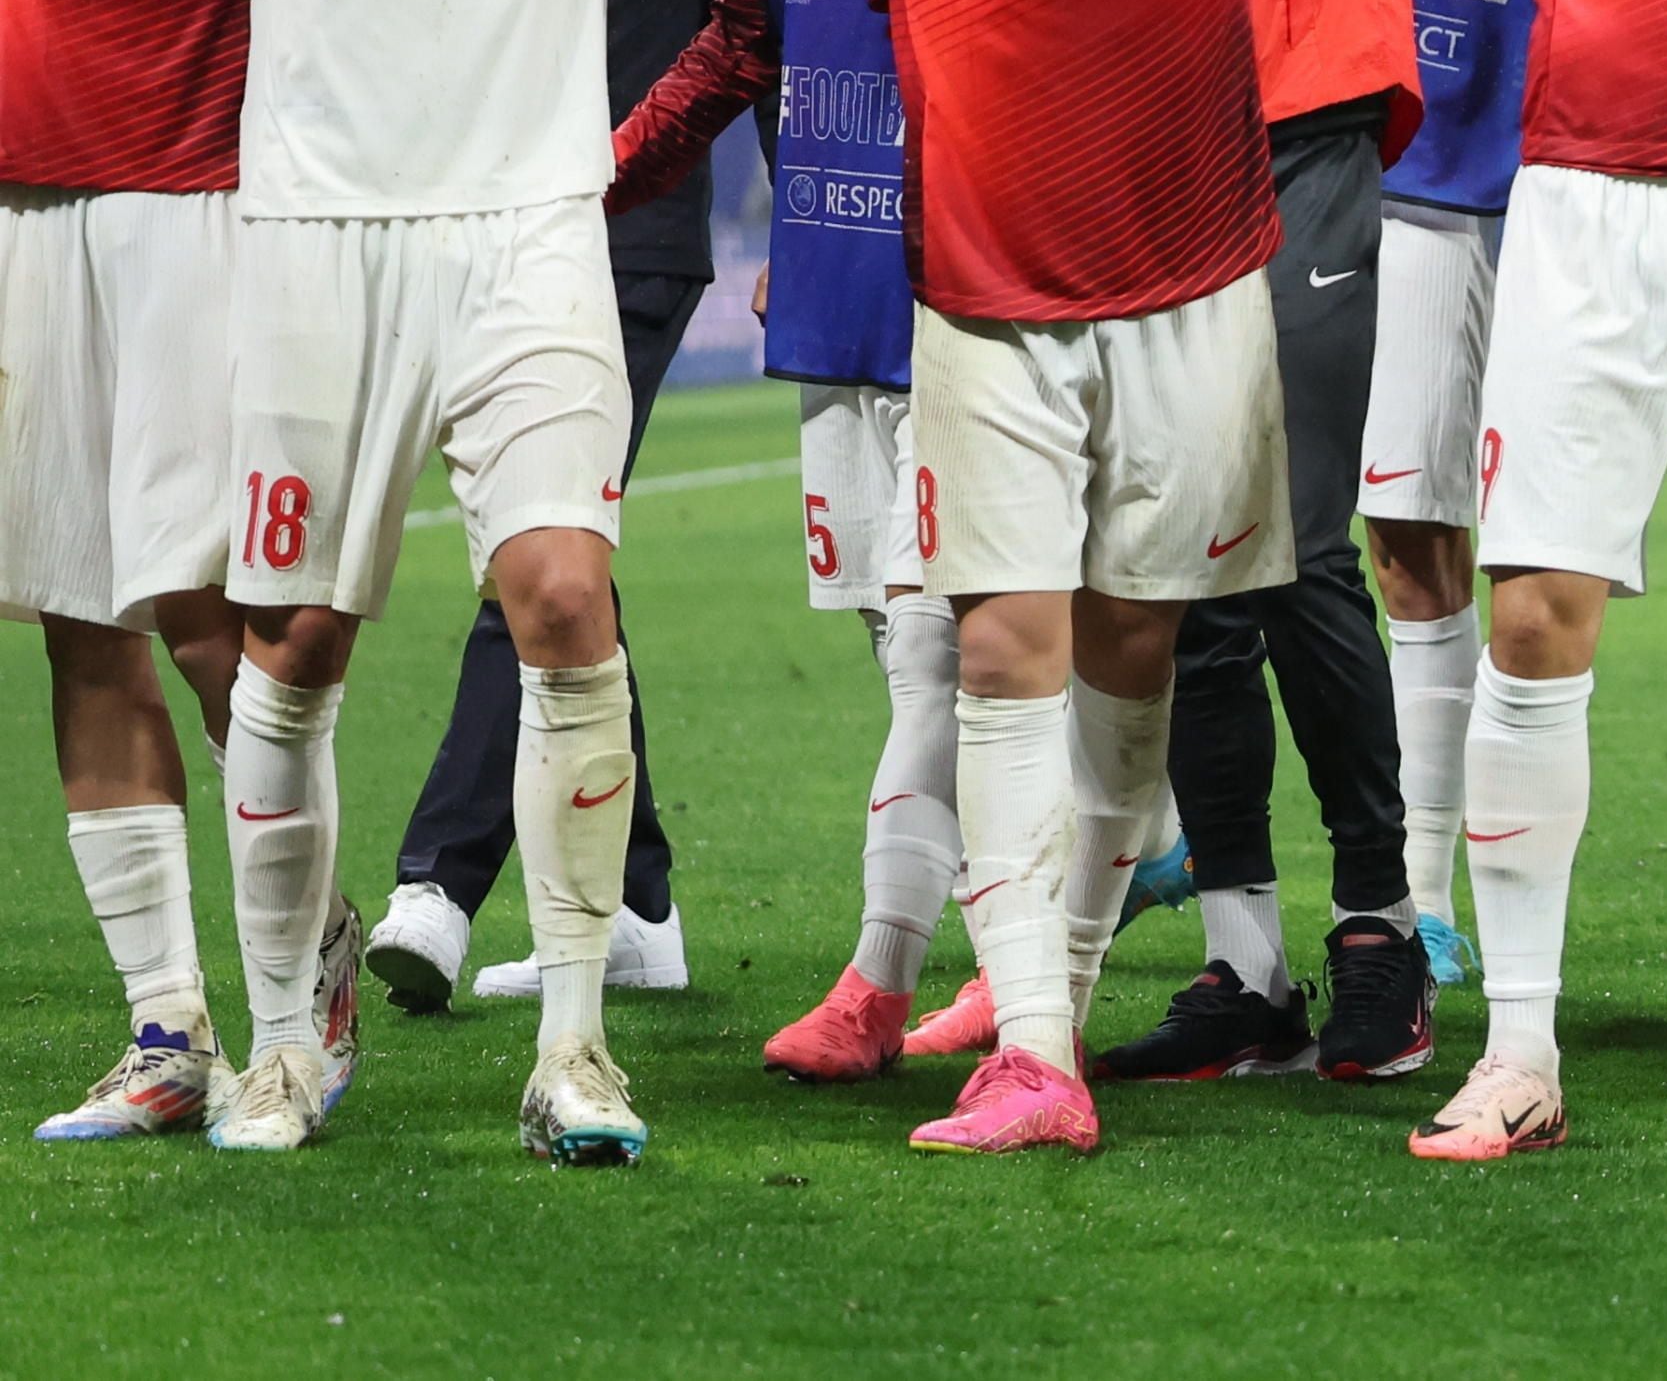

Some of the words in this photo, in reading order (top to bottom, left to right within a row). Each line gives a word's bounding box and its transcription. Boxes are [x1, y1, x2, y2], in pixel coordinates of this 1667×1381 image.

[243, 471, 313, 573] 18
[916, 466, 940, 564] 8
[1481, 427, 1504, 525] 9
[804, 493, 842, 580] 5
